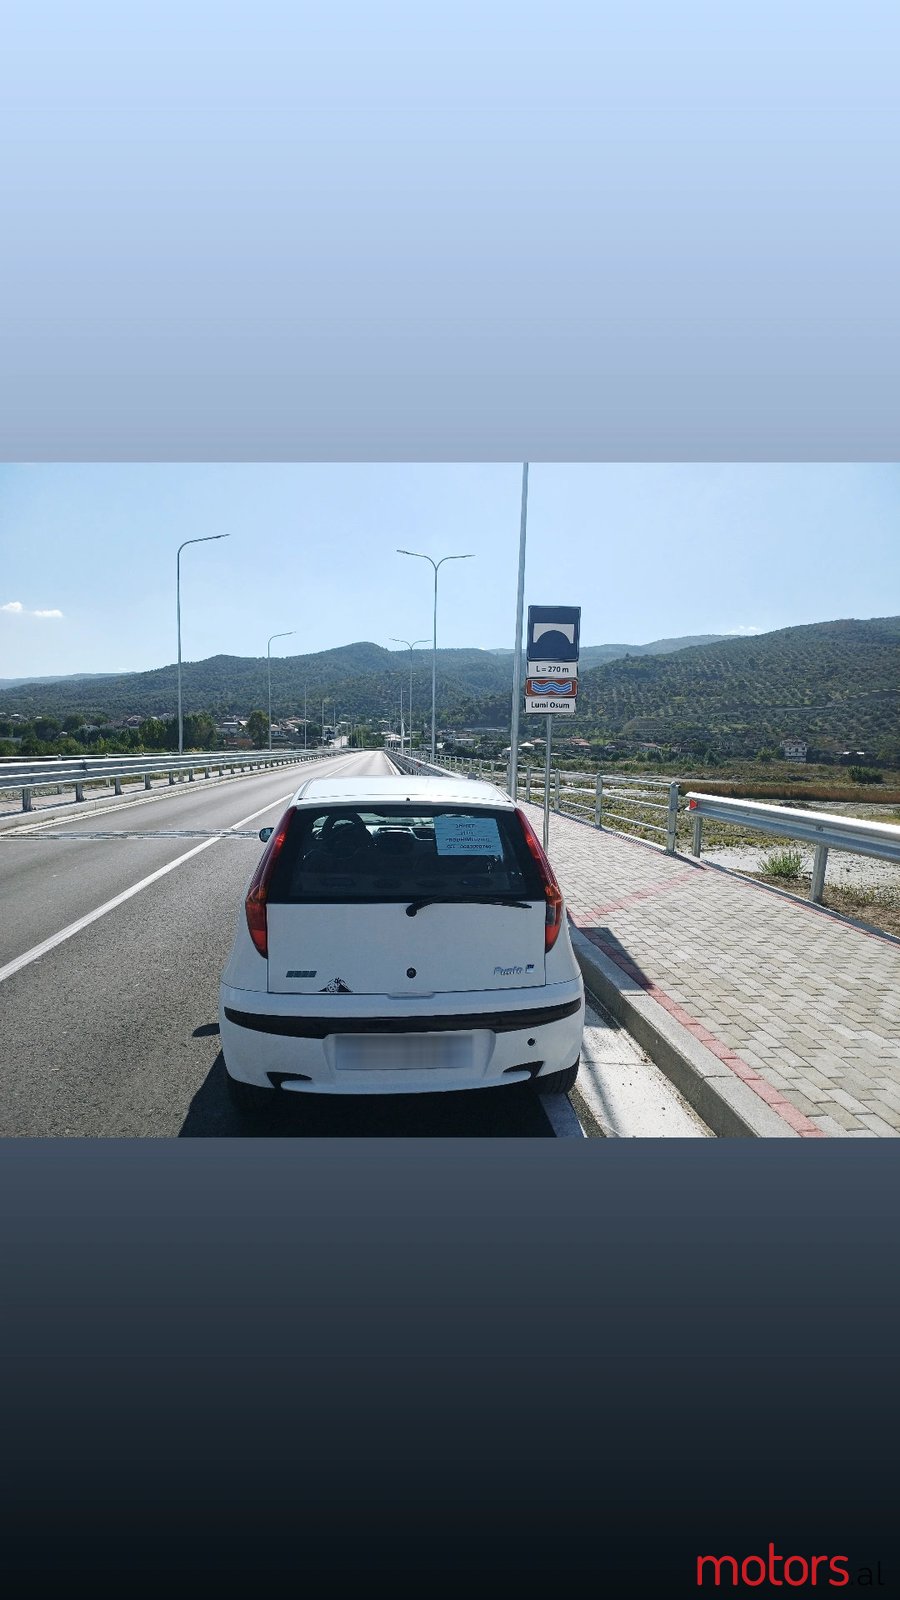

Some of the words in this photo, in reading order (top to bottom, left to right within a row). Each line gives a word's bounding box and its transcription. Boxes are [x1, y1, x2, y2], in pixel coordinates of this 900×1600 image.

[536, 665, 540, 673] L
[548, 665, 561, 673] 270
[531, 701, 548, 709] Lumi
[550, 701, 570, 709] Osum
